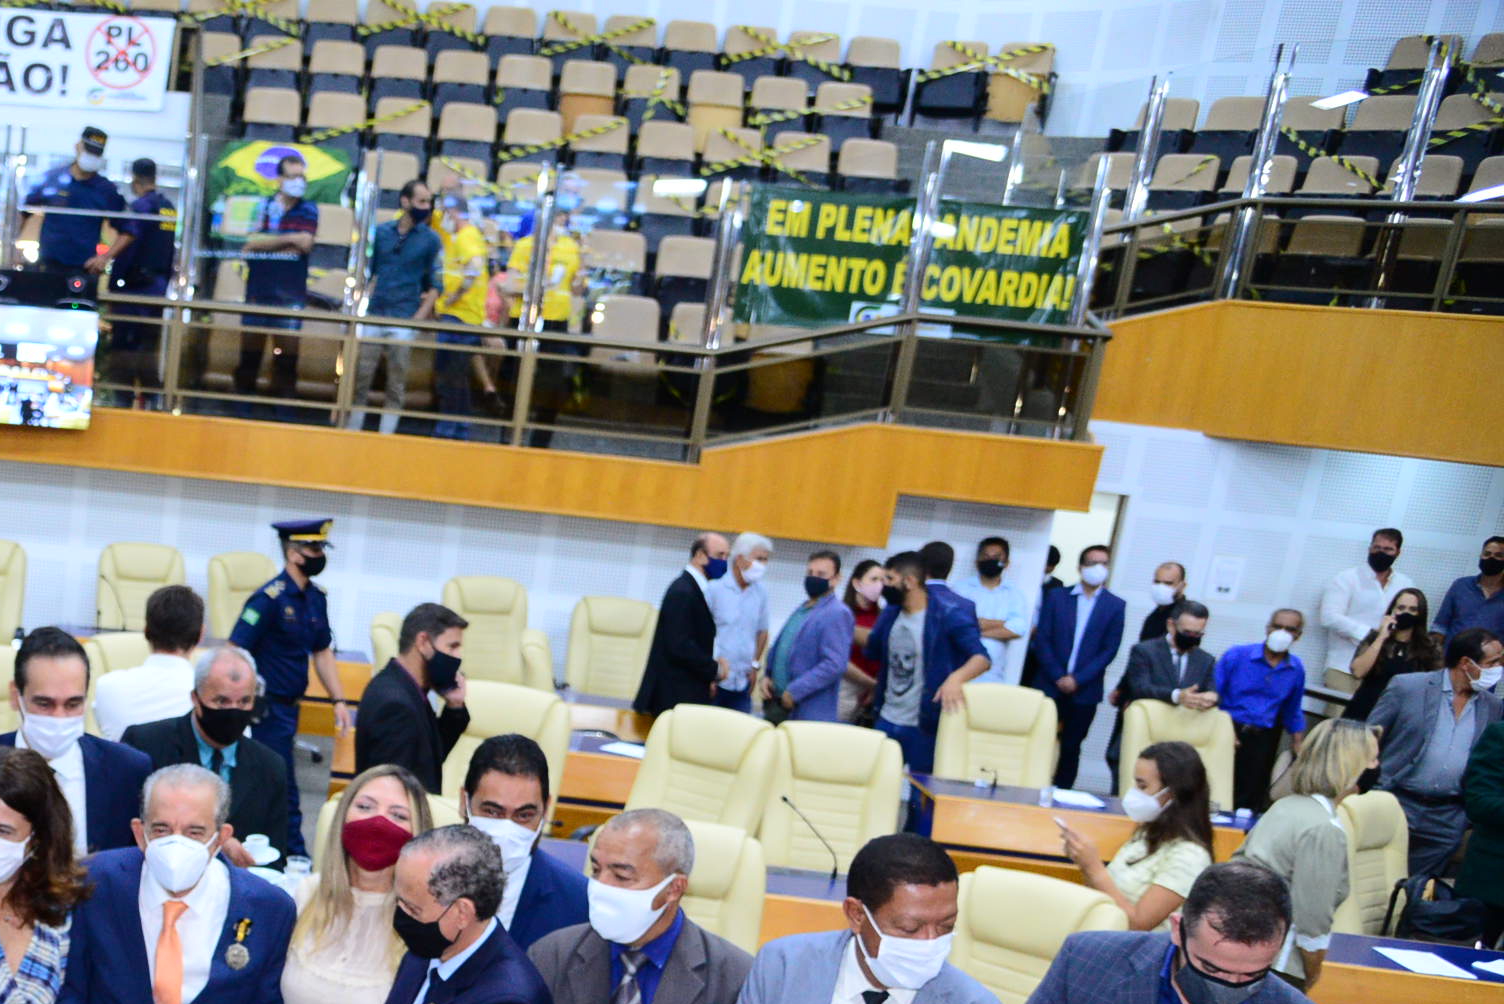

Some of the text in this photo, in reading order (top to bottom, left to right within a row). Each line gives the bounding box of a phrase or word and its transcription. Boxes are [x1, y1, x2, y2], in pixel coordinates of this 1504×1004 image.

[107, 25, 141, 47] PL
[96, 50, 148, 73] 260
[766, 200, 1071, 259] EM PLENA ANDEMIA
[741, 250, 887, 296] AUMENTO
[921, 263, 1077, 312] COVARDIA!
